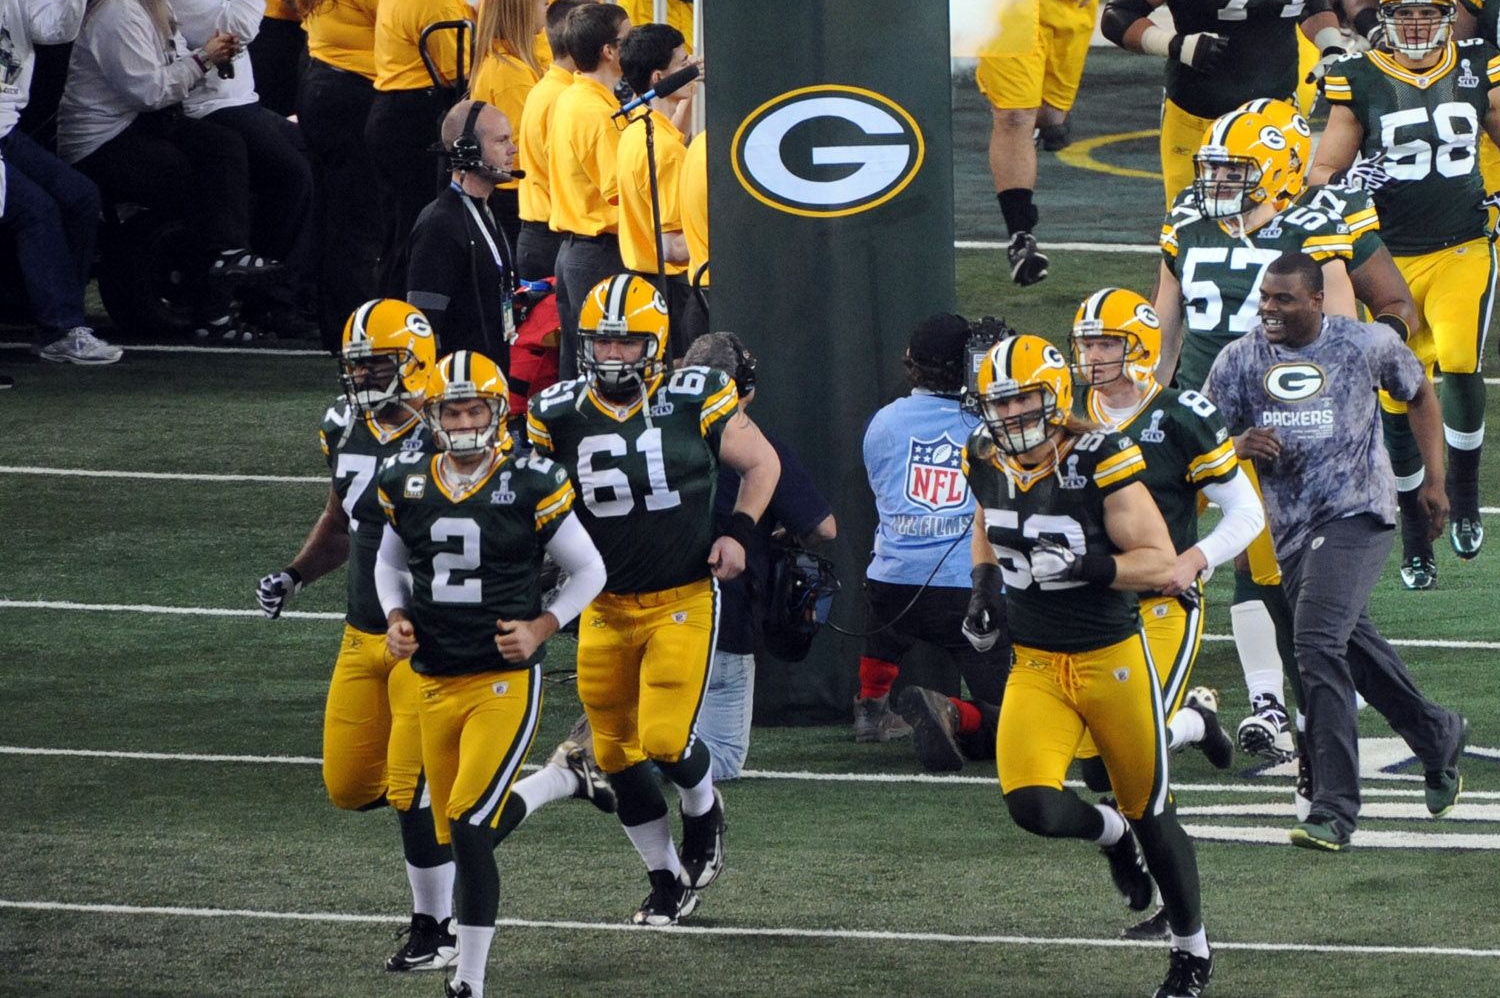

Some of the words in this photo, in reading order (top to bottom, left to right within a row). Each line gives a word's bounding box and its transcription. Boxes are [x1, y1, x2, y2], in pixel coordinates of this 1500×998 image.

[744, 98, 910, 205] G
[1380, 102, 1478, 181] 58
[1178, 247, 1283, 332] 57
[1263, 409, 1334, 427] PACKERS
[1267, 366, 1322, 399] G
[577, 427, 681, 518] 61
[911, 467, 962, 505] NFL
[430, 517, 482, 602] 2
[920, 515, 975, 537] FILMS
[984, 509, 1090, 591] 52
